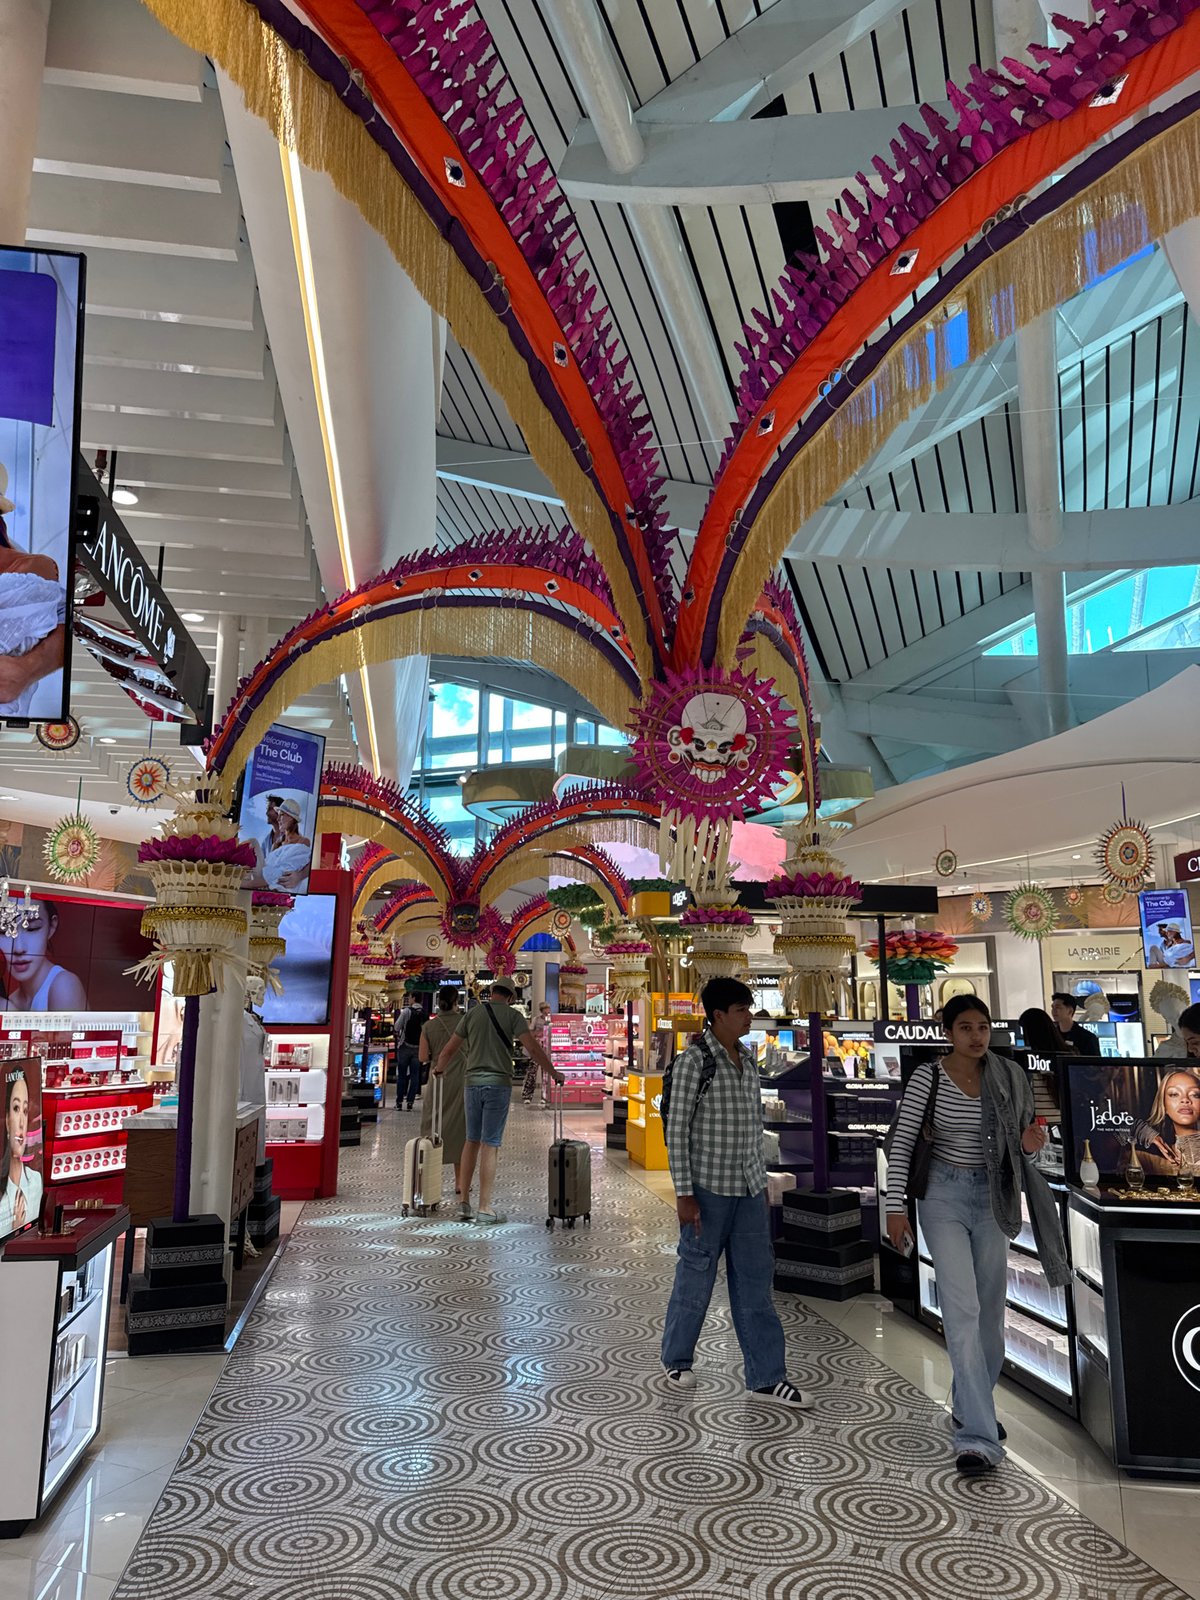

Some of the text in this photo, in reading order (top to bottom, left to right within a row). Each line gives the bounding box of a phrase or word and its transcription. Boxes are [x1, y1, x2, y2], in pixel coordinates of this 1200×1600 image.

[260, 744, 303, 763] The Club
[291, 742, 298, 750] to
[1068, 947, 1120, 956] LA PRAIRIE
[763, 977, 779, 985] Klein
[884, 1025, 946, 1041] CAUDAL
[1027, 1054, 1051, 1072] Dior
[1090, 1099, 1134, 1132] j'adore
